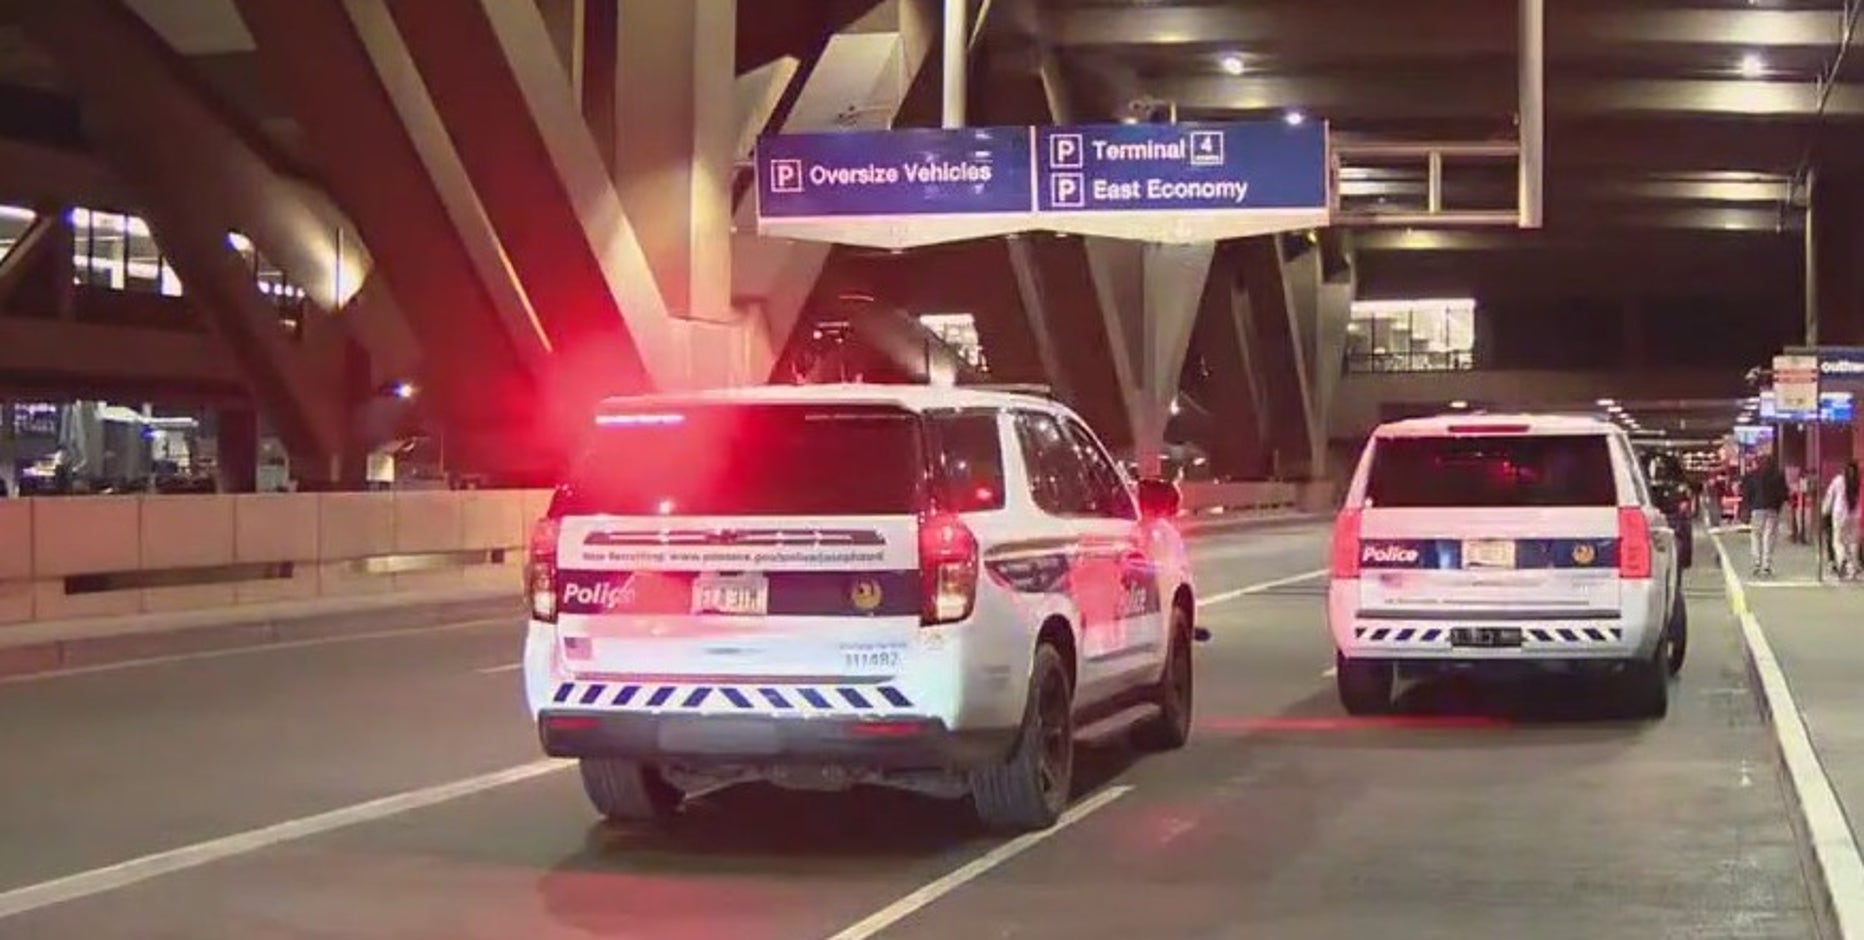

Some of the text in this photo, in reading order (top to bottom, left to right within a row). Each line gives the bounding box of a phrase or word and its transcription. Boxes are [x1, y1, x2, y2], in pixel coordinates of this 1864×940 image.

[1057, 136, 1212, 162] P Terminal 4
[777, 161, 992, 187] P Oversize Vehicles
[1058, 178, 1248, 203] P East Economy
[1362, 546, 1418, 562] Police
